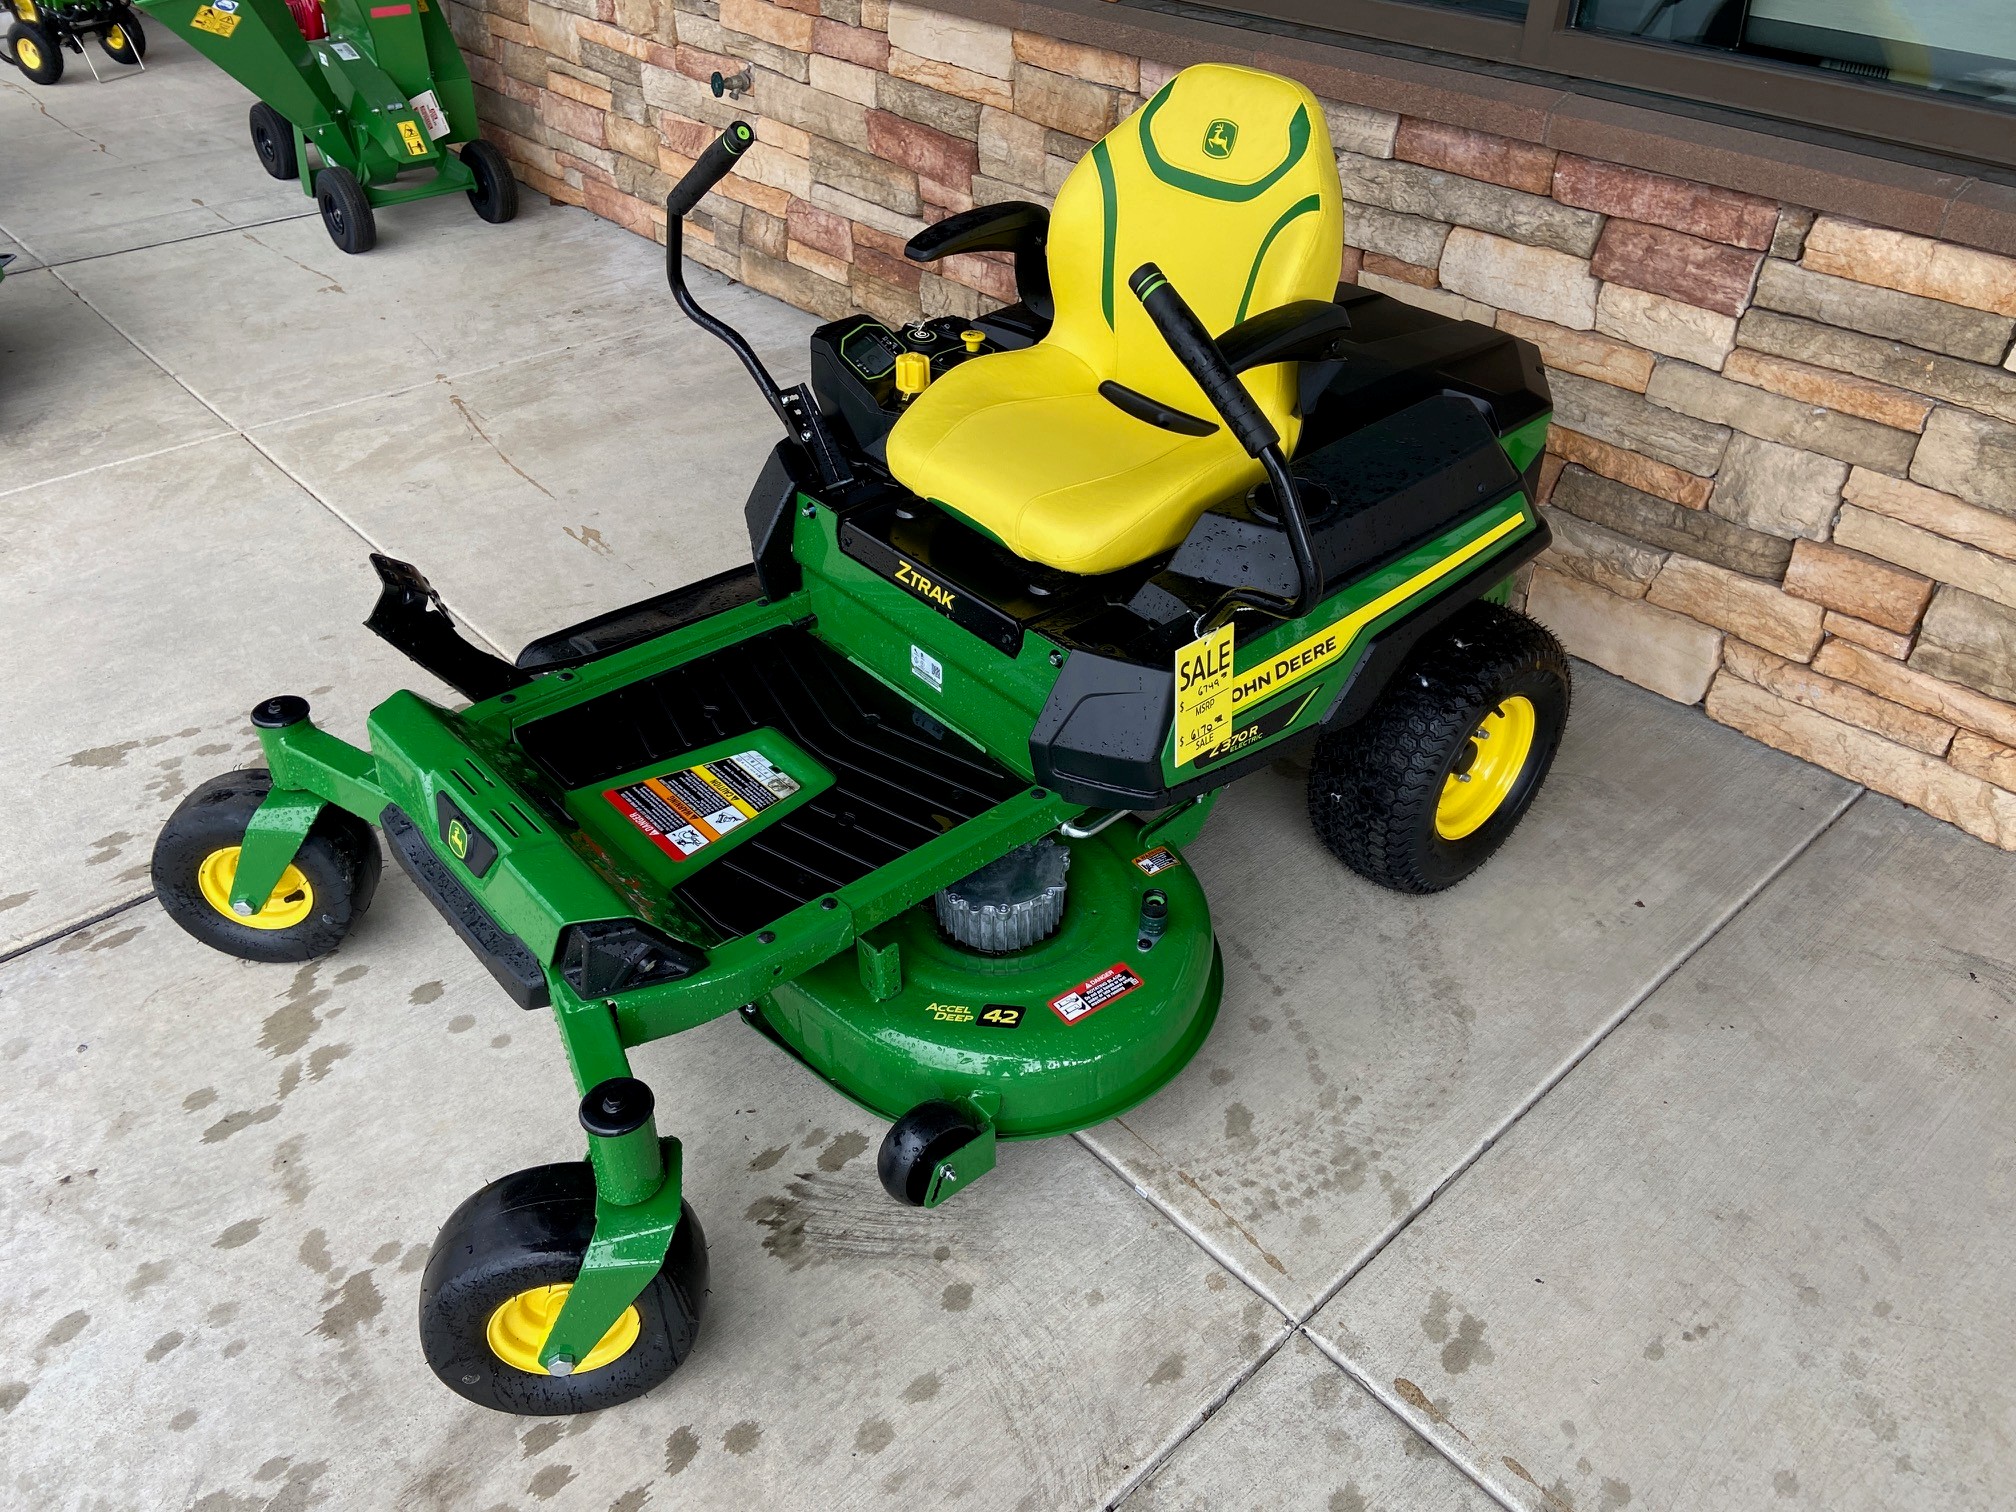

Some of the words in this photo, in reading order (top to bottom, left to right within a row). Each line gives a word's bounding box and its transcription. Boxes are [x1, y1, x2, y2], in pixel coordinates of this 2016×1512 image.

[894, 559, 956, 611] ZTRAK
[1180, 640, 1231, 692] SALE
[1232, 671, 1272, 703] OHN
[1274, 635, 1337, 680] DEERE
[1180, 701, 1184, 713] $
[1195, 698, 1215, 717] MSRP
[1180, 736, 1184, 747] $
[1195, 732, 1214, 751] SALE
[1229, 732, 1264, 753] ELECTRIC
[710, 779, 733, 797] CAUTION
[667, 795, 692, 819] WARNING
[629, 811, 651, 832] DANGER
[1090, 970, 1115, 985] DANGER
[925, 1002, 972, 1014] ACCEL
[933, 1011, 974, 1022] DEEP
[983, 1009, 1019, 1024] 42
